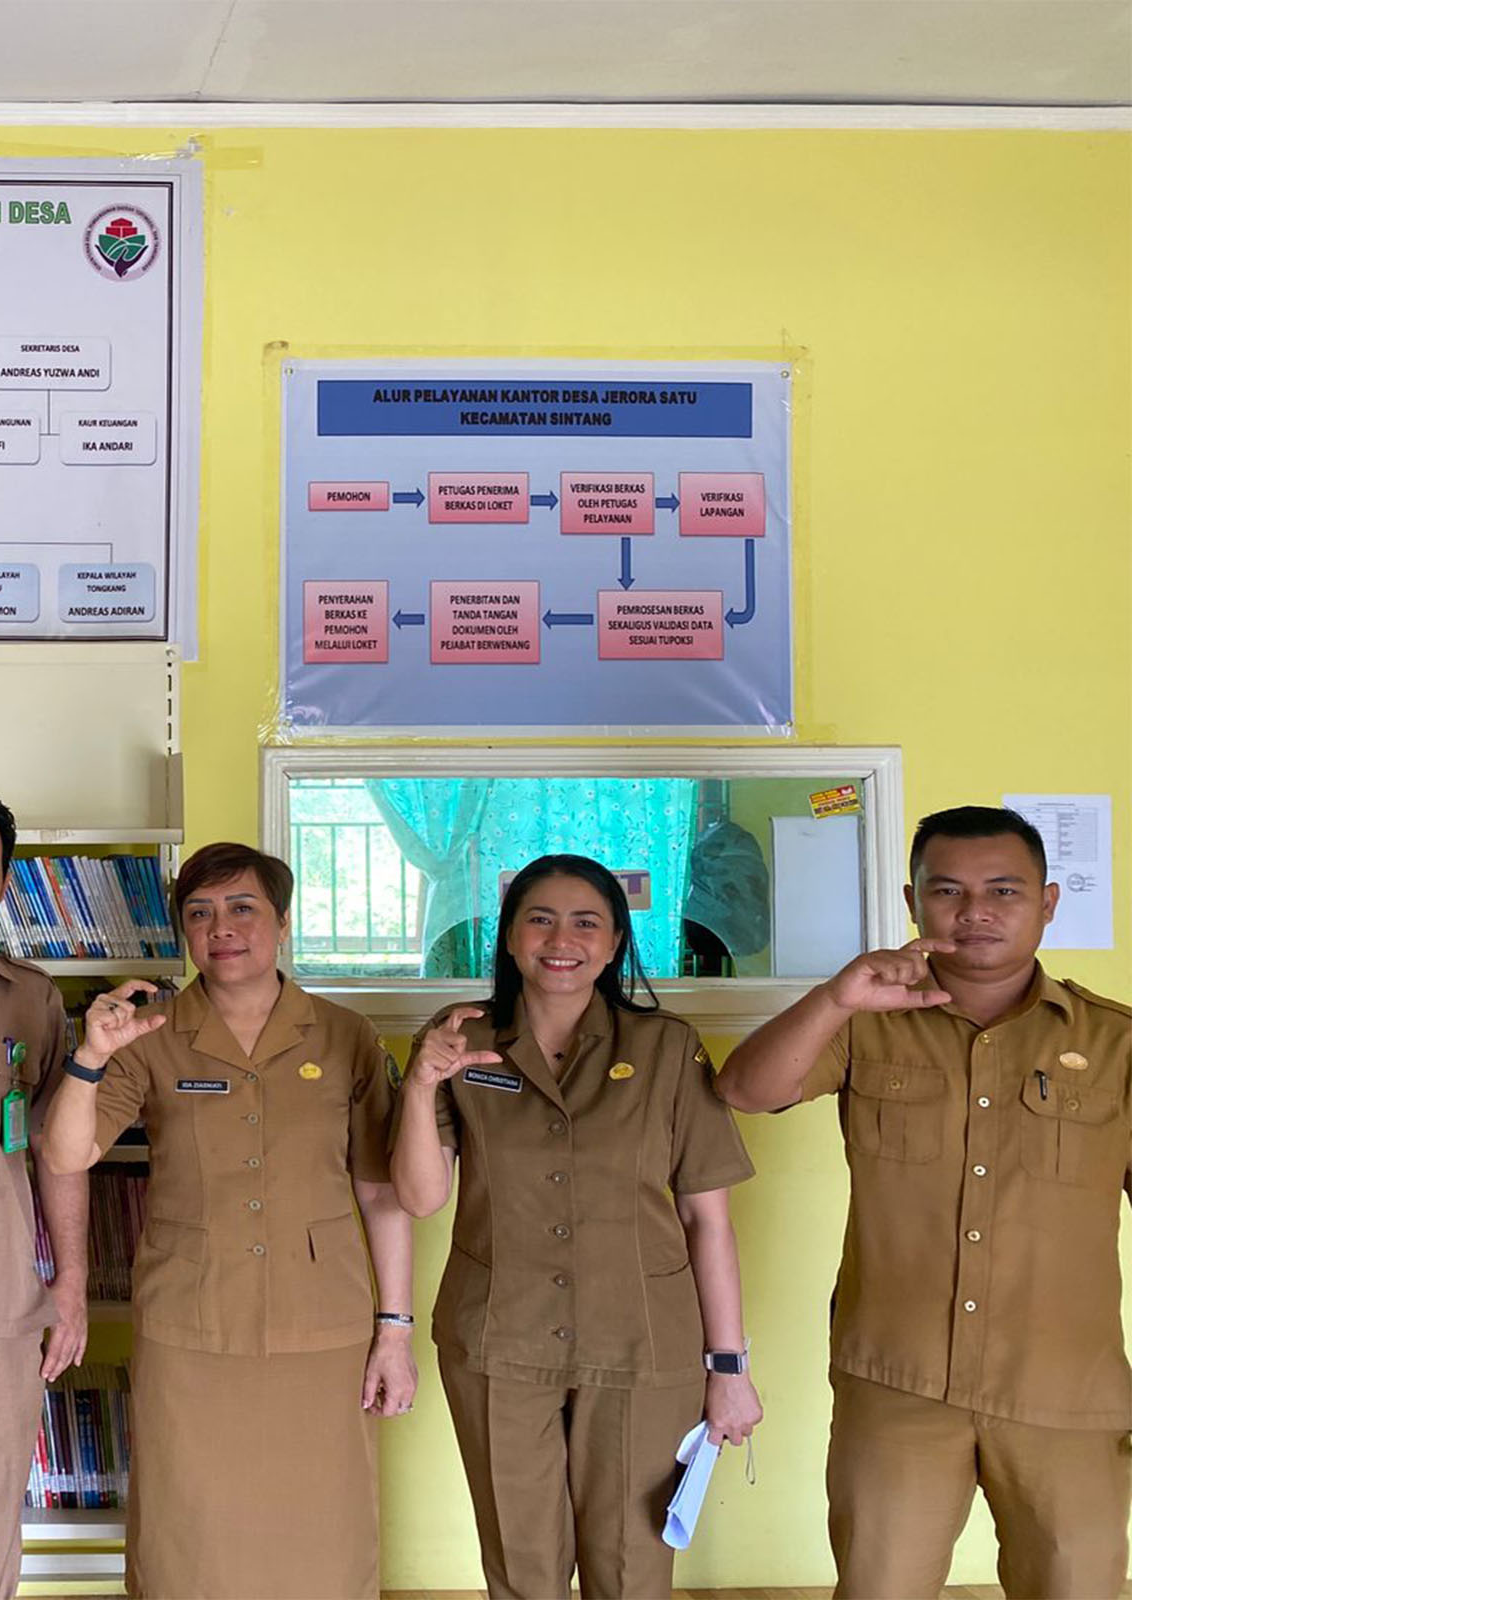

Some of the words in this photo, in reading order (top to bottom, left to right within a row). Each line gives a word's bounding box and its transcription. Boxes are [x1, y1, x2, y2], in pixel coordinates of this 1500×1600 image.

[8, 200, 71, 224] DESA
[20, 344, 61, 352] SEKRETARIS
[61, 344, 80, 353] DESA
[0, 367, 42, 377] ANDREAS
[43, 368, 76, 377] YUZWA
[77, 368, 100, 378] ANDI
[373, 389, 411, 403] ALUR
[413, 389, 498, 403] PELAYANAN
[500, 389, 559, 403] KANTOR
[562, 390, 599, 404] DESA
[601, 390, 657, 404] JERORA
[659, 391, 697, 404] SATU
[78, 419, 97, 427] KAUR
[98, 419, 138, 427] KEUANGAN
[460, 411, 547, 425] KECAMATAN
[549, 412, 612, 426] SINTANG
[82, 442, 97, 451] IKA
[99, 441, 133, 451] ANDARI
[438, 485, 476, 495] PETUGAS
[476, 485, 520, 495] PENERIMA
[570, 483, 613, 493] VERIFIKASI
[614, 483, 645, 494] BERKAS
[326, 491, 371, 502] PEMOHON
[700, 492, 744, 502] VERIFIKASI
[444, 500, 476, 510] BERKAS
[477, 500, 486, 510] DI
[487, 500, 513, 510] LOKET
[577, 498, 599, 508] OLEH
[600, 498, 638, 509] PETUGAS
[699, 507, 745, 517] LAPANGAN
[583, 514, 632, 523] PELAYANAN
[77, 572, 103, 580] KEPALA
[87, 584, 126, 592] TONGKANG
[318, 595, 374, 604] PENYERAHAN
[449, 595, 501, 605] PENERBITAN
[502, 595, 520, 605] DAN
[68, 607, 109, 616] ANDREAS
[110, 606, 145, 616] ADIRAN
[324, 609, 356, 620] BERKAS
[357, 609, 367, 619] KE
[452, 610, 482, 620] TANDA
[483, 610, 518, 620] TANGAN
[616, 605, 672, 615] PEMROSESAN
[673, 605, 704, 615] BERKAS
[324, 624, 368, 635] PEMOHON
[452, 625, 496, 635] DOKUMEN
[496, 625, 519, 635] OLEH
[608, 620, 652, 630] SEKALIGUS
[652, 620, 689, 630] VALIDASI
[690, 620, 713, 630] DATA
[314, 640, 351, 650] MELALUI
[351, 639, 378, 650] LOKET
[440, 640, 475, 650] PEJABAT
[476, 640, 530, 650] BERWENANG
[628, 635, 657, 645] SESUAI
[658, 635, 694, 645] TUPOKSI
